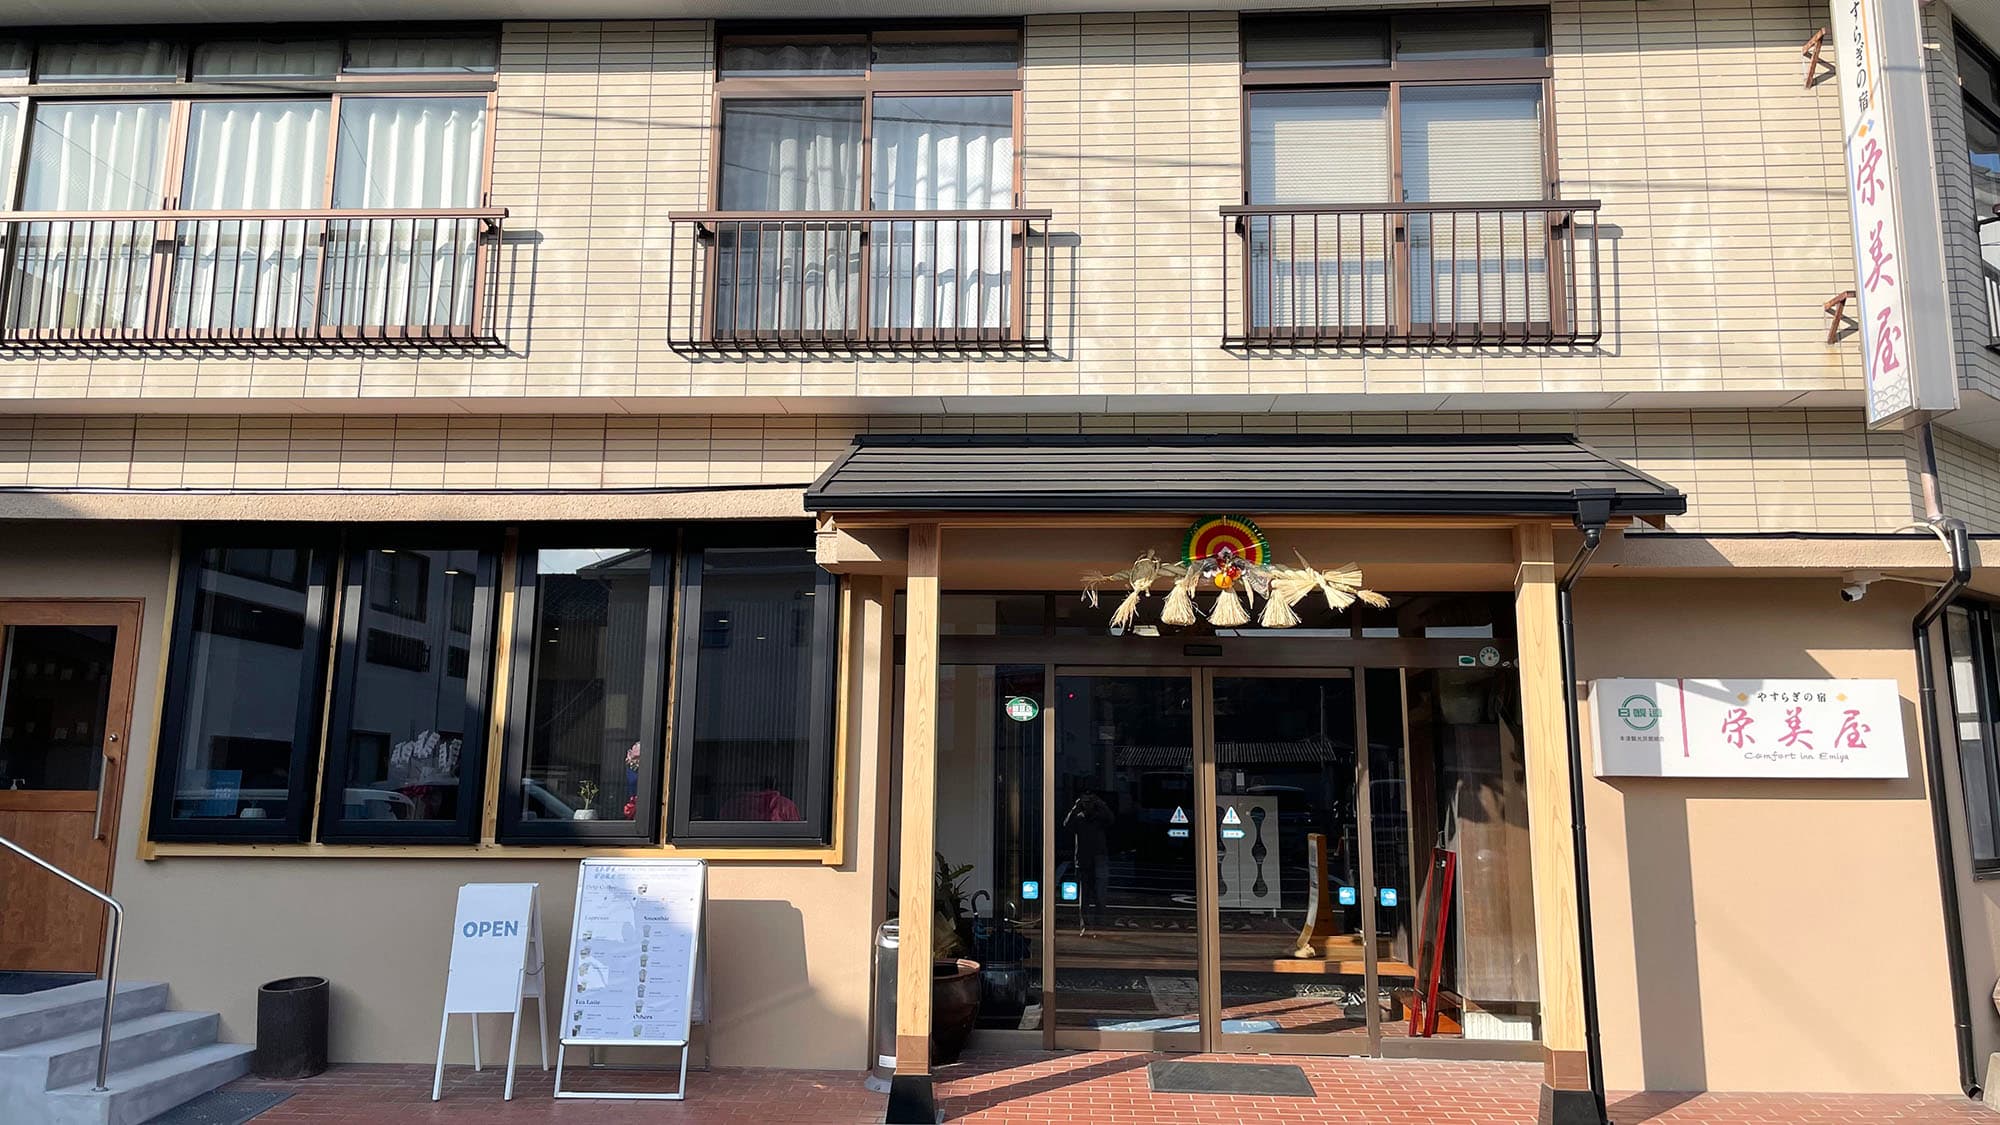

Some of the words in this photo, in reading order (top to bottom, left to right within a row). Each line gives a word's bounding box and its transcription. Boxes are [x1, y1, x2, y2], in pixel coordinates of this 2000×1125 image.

[1855, 138, 1902, 383] 栄美屋
[1757, 691, 1827, 703] やすらぎの宿
[1721, 706, 1871, 750] 栄美屋
[1744, 751, 1797, 762] Comfort
[1818, 752, 1850, 763] Emiya
[463, 920, 519, 938] OPEN
